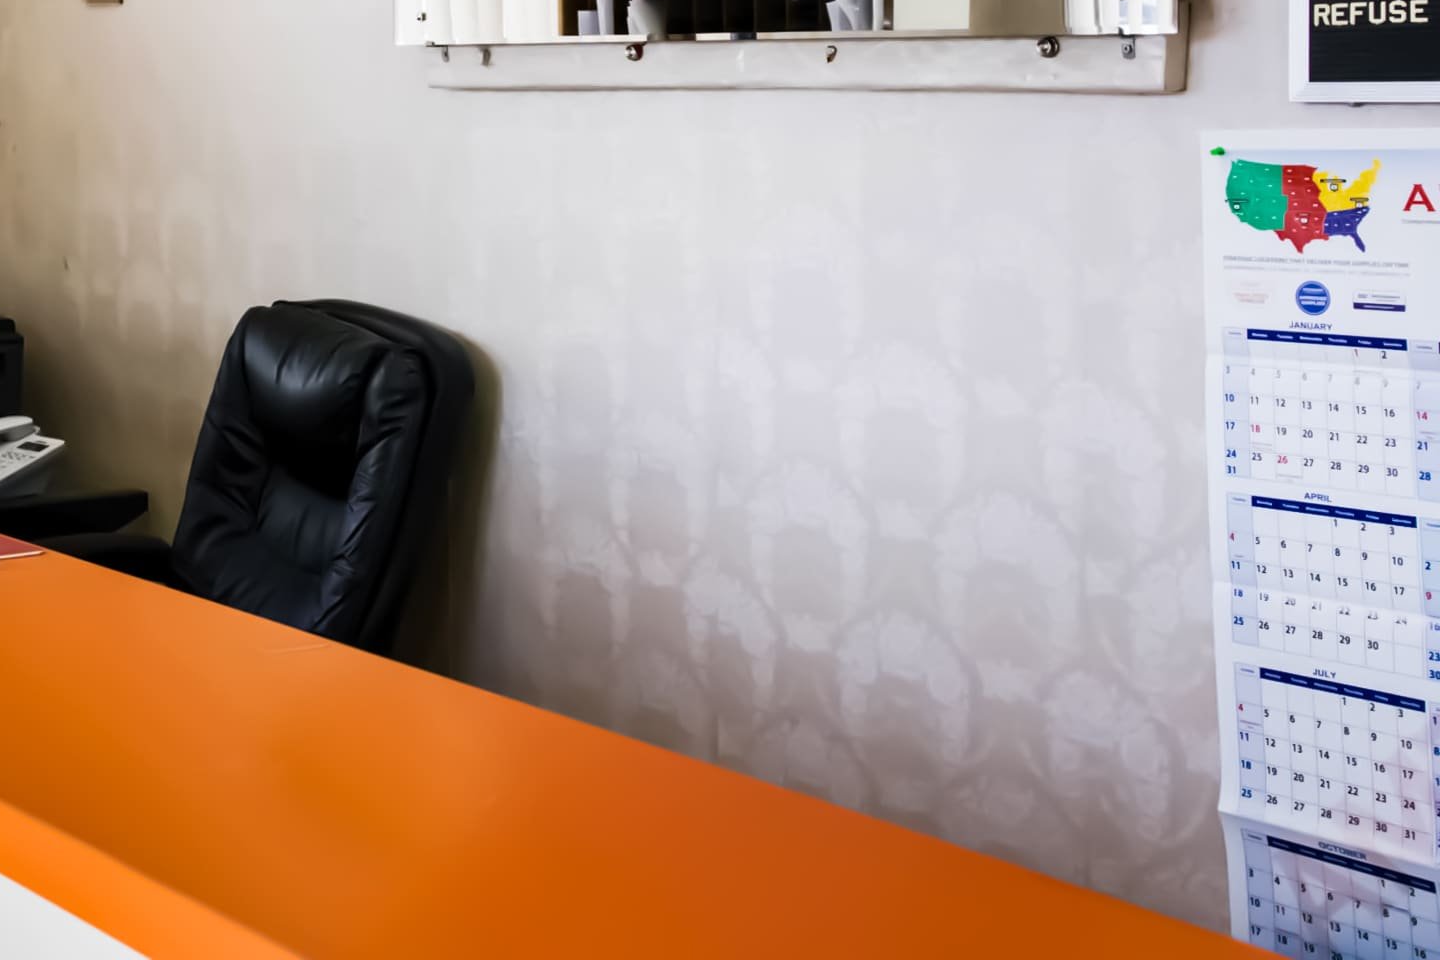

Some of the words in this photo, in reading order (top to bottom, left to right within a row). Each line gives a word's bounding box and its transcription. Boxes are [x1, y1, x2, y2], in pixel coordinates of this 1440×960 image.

[1289, 321, 1333, 331] JANUARY
[1381, 350, 1388, 359] 2
[1224, 393, 1235, 402] 10
[1250, 396, 1260, 405] 11
[1275, 399, 1286, 408] 12
[1301, 401, 1312, 410] 13
[1328, 403, 1339, 412] 14
[1356, 405, 1367, 415] 15
[1384, 408, 1396, 418] 16
[1416, 411, 1428, 421] 14
[1225, 421, 1236, 430] 17
[1251, 425, 1261, 433] 18
[1276, 427, 1287, 436] 19
[1302, 429, 1313, 439] 20
[1329, 432, 1340, 441] 21
[1356, 435, 1368, 445] 22
[1385, 438, 1396, 448] 23
[1417, 441, 1429, 451] 21
[1225, 449, 1237, 458] 24
[1251, 453, 1262, 462] 25
[1277, 455, 1288, 464] 26
[1303, 459, 1314, 467] 27
[1330, 462, 1342, 471] 28
[1358, 465, 1370, 474] 29
[1386, 468, 1398, 477] 30
[1226, 465, 1237, 474] 31
[1419, 471, 1432, 481] 28
[1304, 493, 1332, 503] APRIL
[1333, 519, 1338, 527] 1
[1360, 523, 1366, 532] 2
[1389, 527, 1395, 535] 3
[1230, 533, 1235, 541] 4
[1255, 537, 1261, 545] 5
[1280, 540, 1286, 549] 6
[1307, 544, 1313, 553] 7
[1335, 548, 1341, 557] 8
[1361, 552, 1368, 561] 9
[1392, 556, 1404, 566] 10
[1425, 562, 1431, 571] 2
[1231, 561, 1240, 570] 11
[1256, 564, 1267, 574] 12
[1283, 569, 1294, 578] 13
[1310, 573, 1321, 582] 14
[1337, 577, 1348, 587] 15
[1365, 582, 1377, 592] 16
[1394, 586, 1405, 595] 17
[1233, 589, 1244, 598] 18
[1425, 592, 1432, 601] 9
[1233, 616, 1245, 626] 25
[1259, 621, 1270, 631] 26
[1285, 625, 1296, 635] 27
[1312, 630, 1323, 640] 28
[1339, 635, 1351, 645] 29
[1367, 640, 1379, 650] 30
[1312, 668, 1337, 679] JULY
[1342, 697, 1347, 706] 1
[1369, 703, 1376, 712] 2
[1398, 709, 1404, 718] 3
[1238, 704, 1244, 712] 4
[1264, 709, 1269, 718] 5
[1289, 715, 1296, 723] 6
[1316, 721, 1322, 729] 7
[1343, 727, 1350, 735] 8
[1370, 733, 1377, 741] 9
[1401, 739, 1412, 750] 10
[1240, 731, 1249, 741] 11
[1265, 738, 1276, 748] 12
[1292, 743, 1303, 754] 13
[1319, 750, 1330, 760] 14
[1346, 756, 1357, 766] 15
[1374, 762, 1386, 773] 16
[1402, 769, 1414, 779] 17
[1241, 760, 1252, 770] 18
[1267, 766, 1277, 776] 19
[1293, 772, 1304, 783] 20
[1320, 779, 1331, 789] 21
[1347, 786, 1359, 796] 22
[1376, 792, 1387, 803] 23
[1403, 799, 1416, 810] 24
[1242, 788, 1252, 798] 25
[1267, 795, 1278, 805] 26
[1294, 801, 1305, 811] 27
[1321, 808, 1332, 819] 28
[1348, 815, 1360, 826] 29
[1376, 822, 1388, 832] 30
[1405, 830, 1416, 840] 31
[1381, 879, 1386, 888] 1
[1409, 888, 1415, 897] 2
[1274, 877, 1280, 885] 4
[1301, 884, 1306, 892] 5
[1327, 892, 1334, 901] 6
[1354, 900, 1361, 909] 7
[1411, 917, 1418, 926] 9
[1250, 897, 1260, 907] 10
[1276, 905, 1285, 916] 11
[1302, 913, 1313, 924] 12
[1330, 922, 1341, 932] 13
[1358, 930, 1369, 941] 14
[1386, 940, 1398, 950] 15
[1414, 948, 1426, 959] 16
[1251, 926, 1261, 936] 17
[1303, 942, 1315, 953] 19
